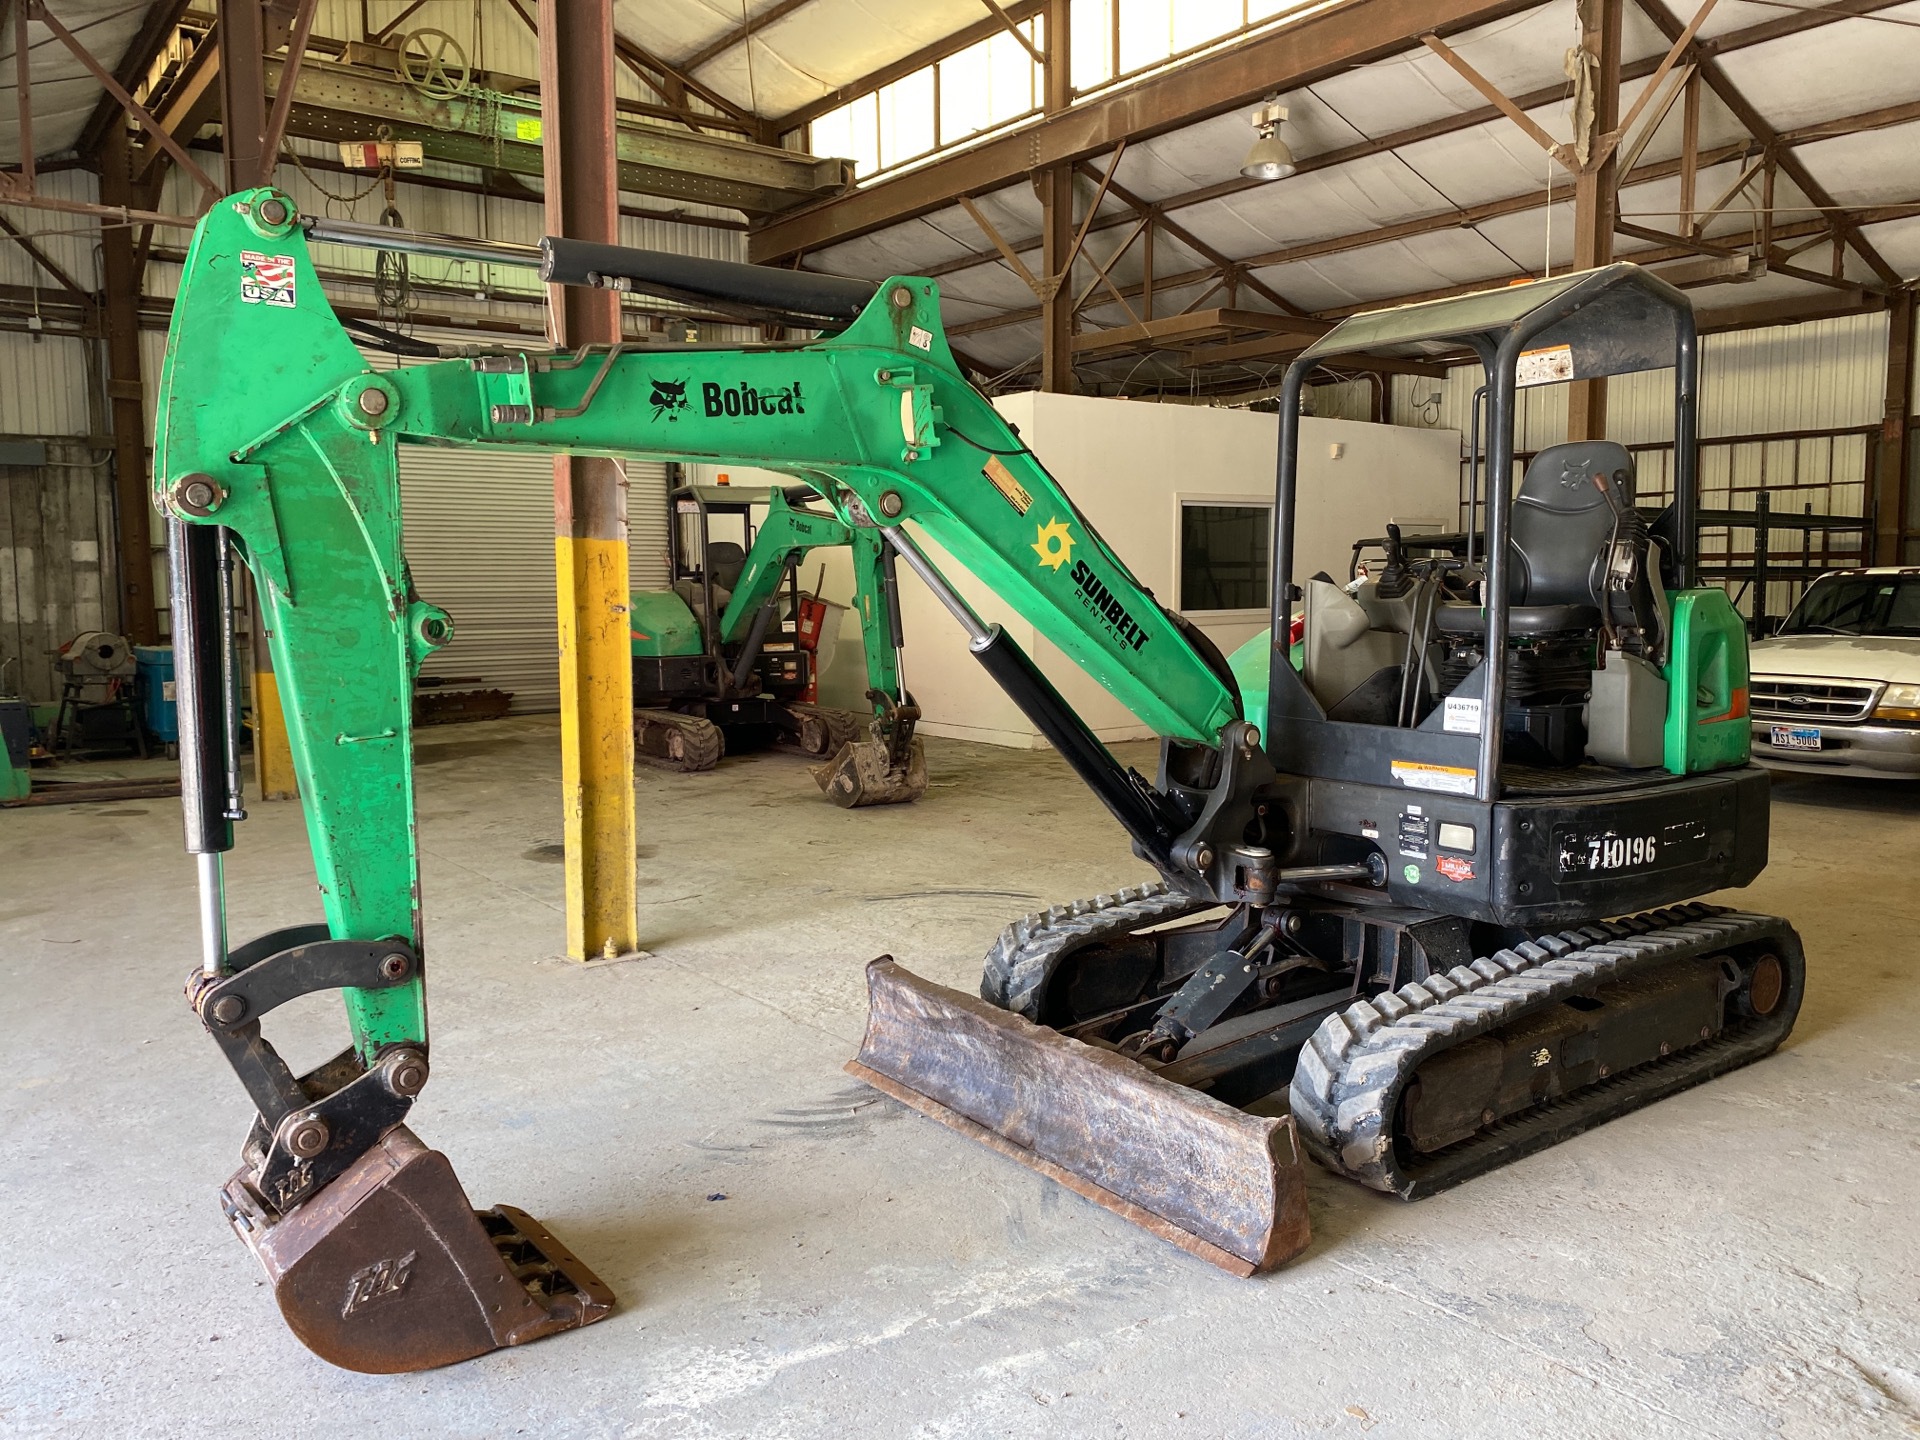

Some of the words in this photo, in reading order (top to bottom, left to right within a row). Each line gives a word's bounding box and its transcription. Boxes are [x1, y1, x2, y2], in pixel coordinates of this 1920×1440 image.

[244, 253, 266, 262] MADE
[278, 257, 291, 265] THE
[244, 285, 292, 302] USA
[702, 381, 806, 417] Bobcat
[1070, 559, 1150, 651] SUNBELT
[1074, 588, 1128, 650] RENTALS
[1447, 703, 1479, 711] U436719
[1588, 835, 1656, 870] 710196
[1445, 862, 1471, 872] MILLION
